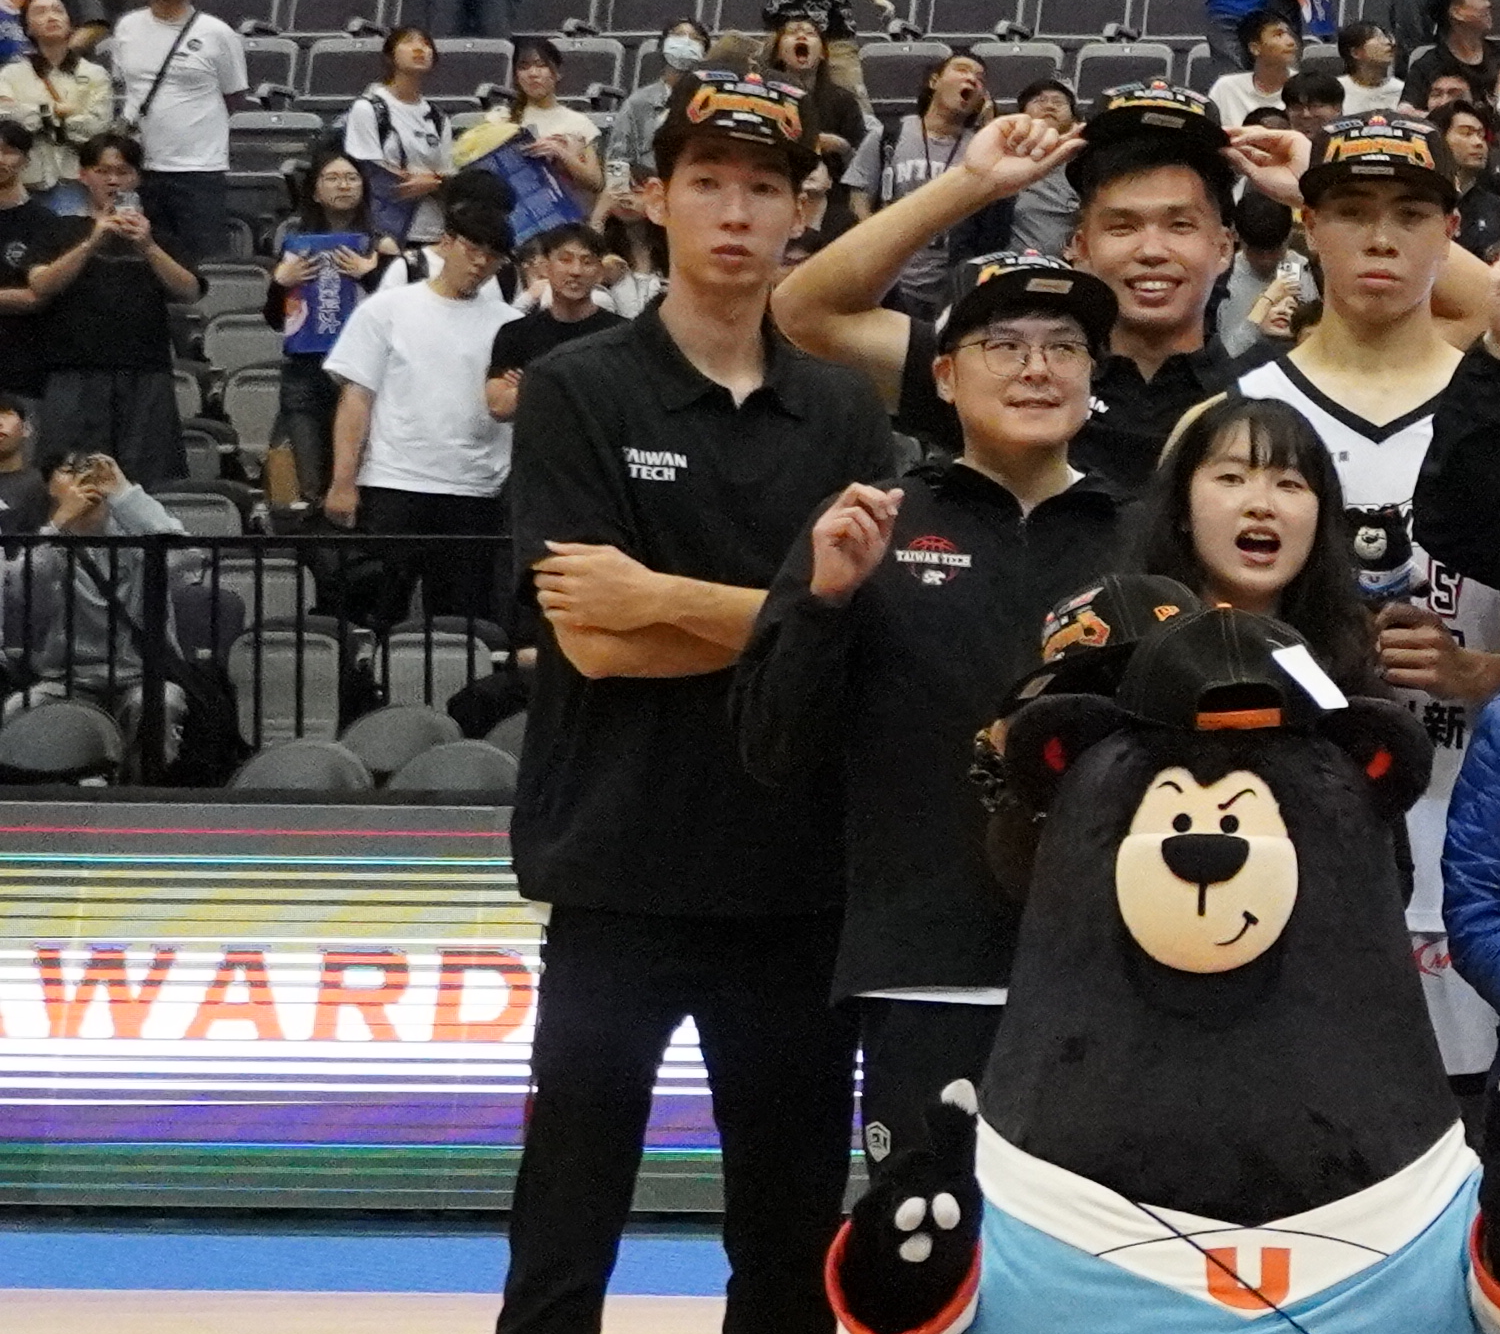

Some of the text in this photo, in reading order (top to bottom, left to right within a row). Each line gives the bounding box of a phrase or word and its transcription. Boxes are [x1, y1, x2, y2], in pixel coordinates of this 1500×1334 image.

[621, 446, 689, 469] TAIWAN
[628, 463, 677, 482] TECH
[896, 548, 972, 568] TAIWAN TECH
[0, 945, 536, 1043] WARD
[1204, 1246, 1292, 1310] U
